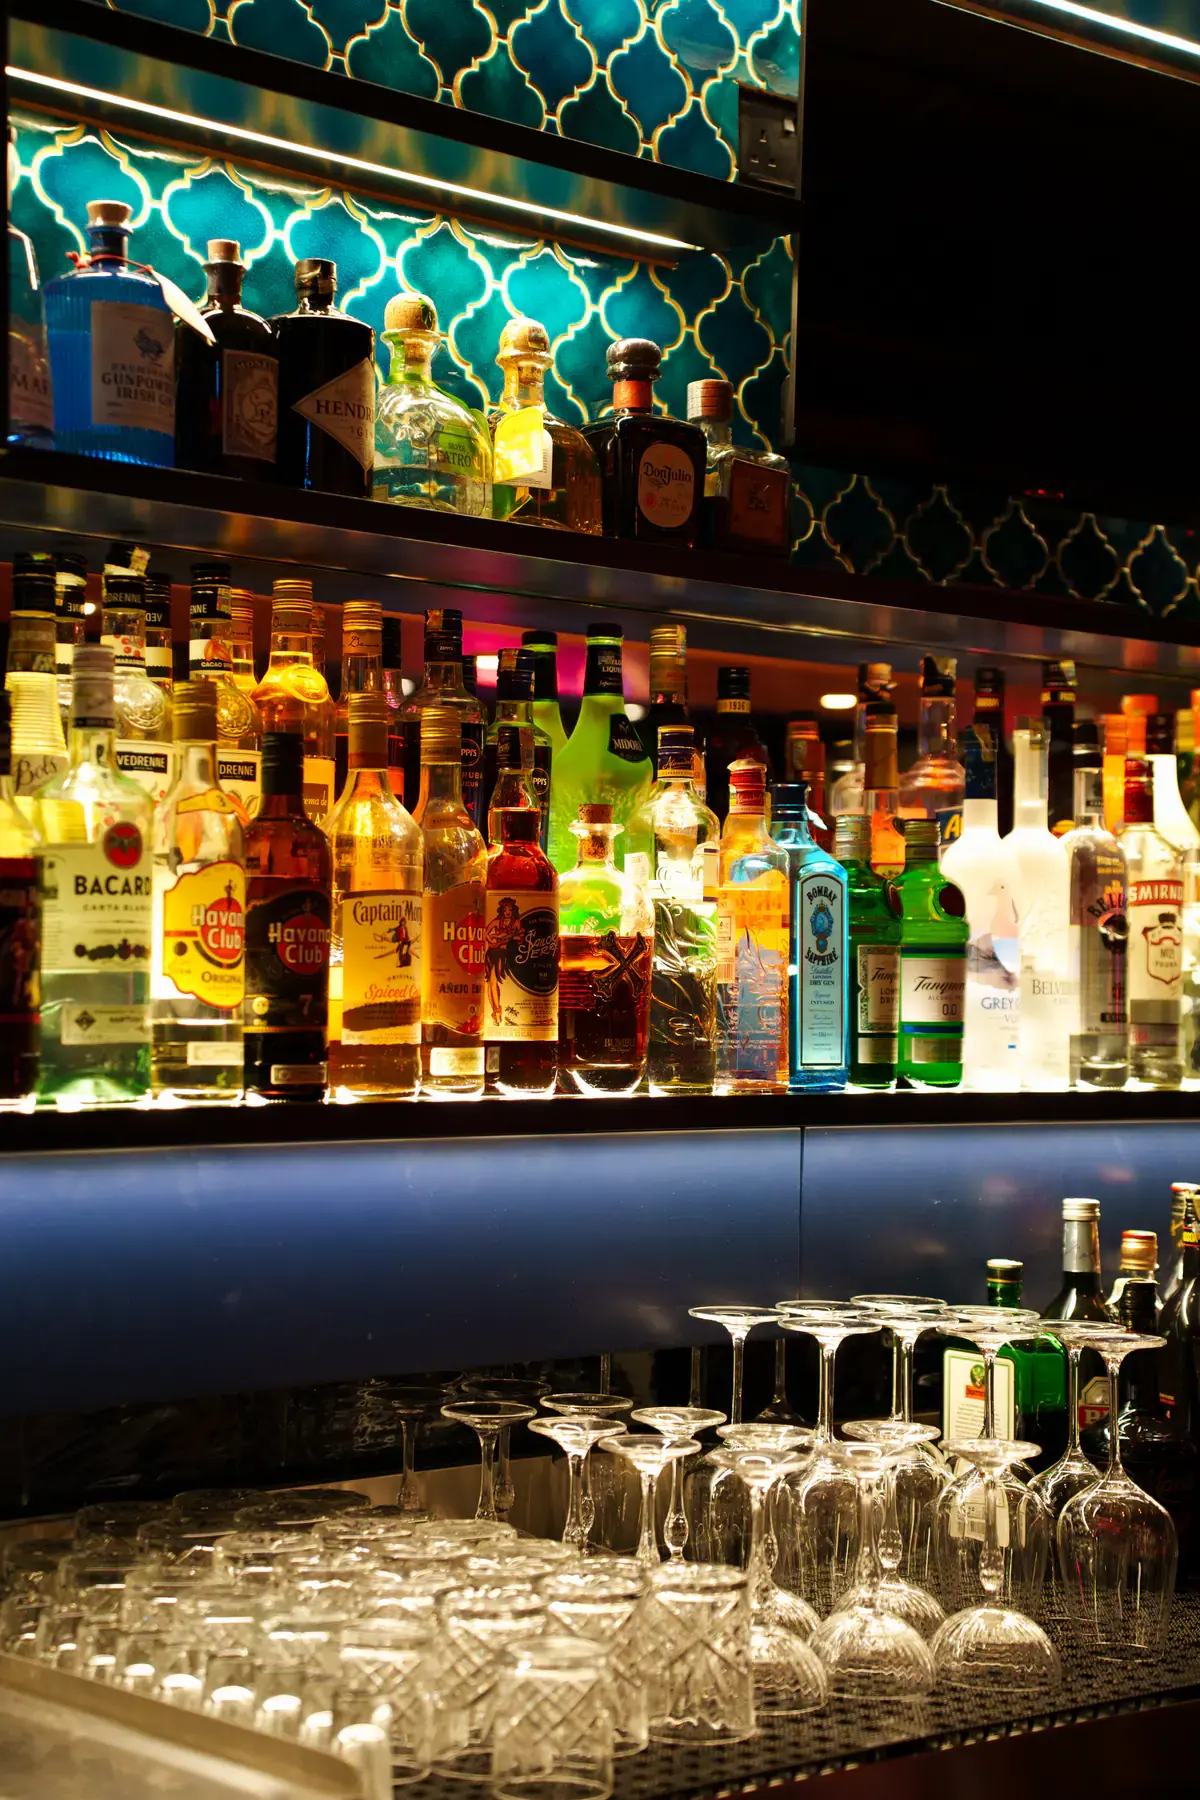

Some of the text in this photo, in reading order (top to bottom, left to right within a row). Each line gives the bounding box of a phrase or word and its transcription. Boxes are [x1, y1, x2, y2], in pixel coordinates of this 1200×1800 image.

[729, 701, 746, 711] 1936
[117, 754, 166, 769] VEDRENNE
[14, 754, 58, 794] Bols
[806, 885, 839, 906] BOMBAY
[353, 899, 402, 926] Captain
[207, 927, 242, 950] Club
[284, 944, 323, 965] Club
[804, 946, 839, 967] SAPPHIRE
[364, 983, 408, 1001] Spiced
[437, 983, 468, 995] AÑEJO
[981, 997, 1013, 1010] GREY
